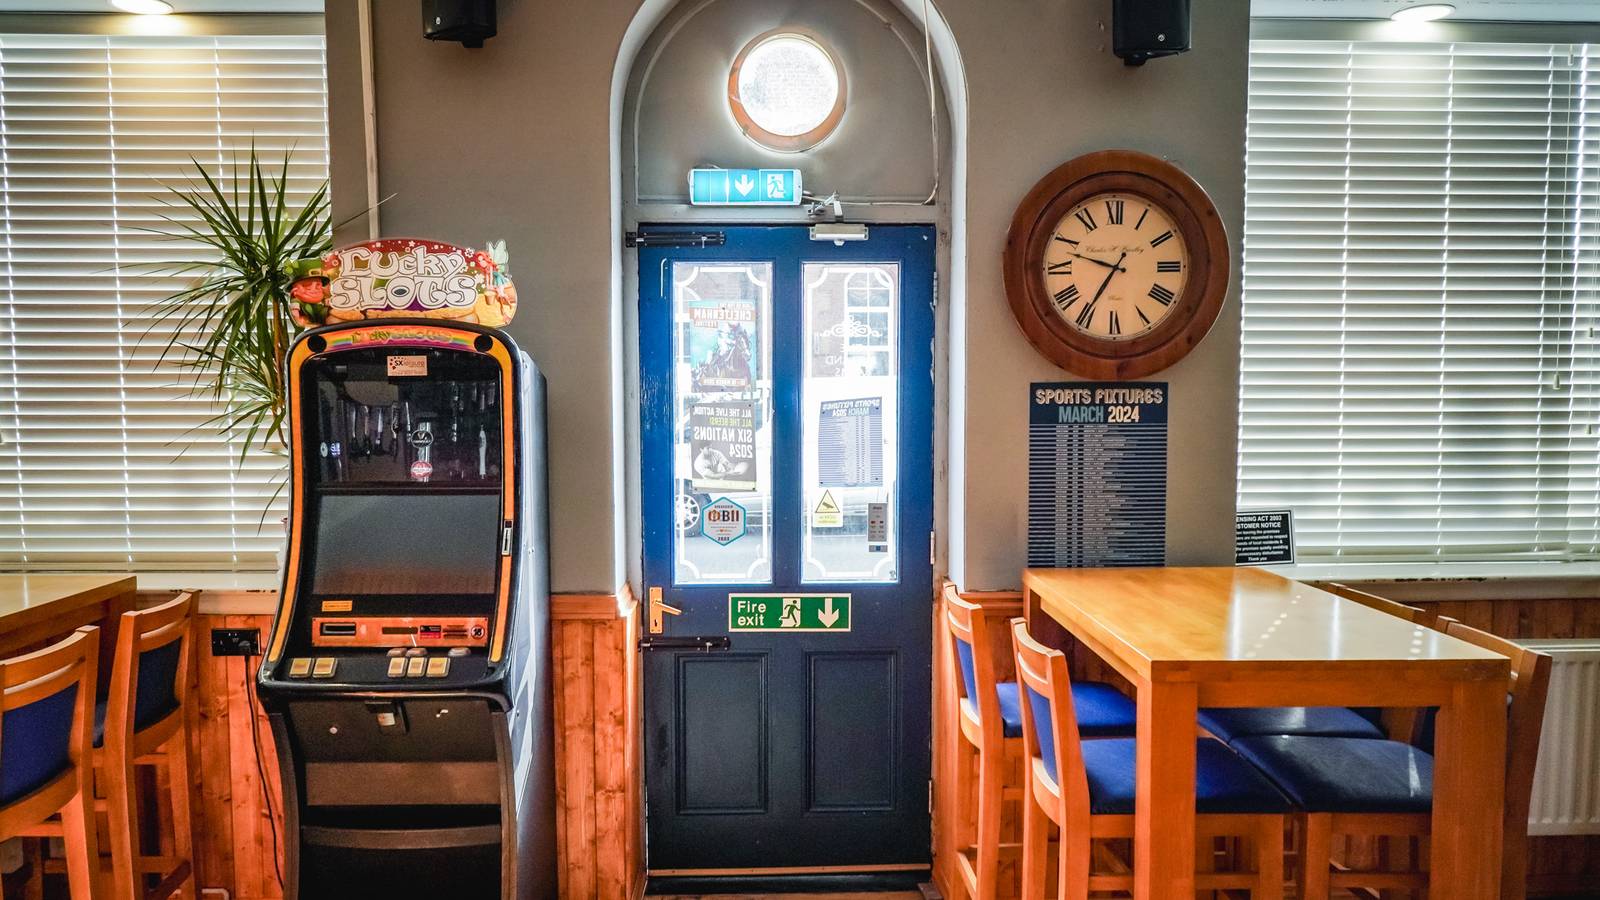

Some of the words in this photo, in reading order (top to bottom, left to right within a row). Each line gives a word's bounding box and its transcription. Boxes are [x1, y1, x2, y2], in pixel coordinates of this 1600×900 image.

[1075, 208, 1098, 234] XI
[1105, 200, 1124, 225] XII
[1134, 208, 1149, 230] I
[1054, 232, 1080, 249] X
[1150, 230, 1173, 248] II
[1157, 261, 1180, 272] III
[330, 276, 478, 309] SLOTS
[1053, 284, 1082, 311] VIII
[1109, 311, 1121, 334] VI
[1036, 389, 1091, 404] SPORTS
[1095, 388, 1163, 404] FIXTURES
[1058, 406, 1104, 423] MARCH
[1108, 406, 1140, 423] 2024
[738, 600, 766, 613] Fire
[738, 614, 764, 626] exit
